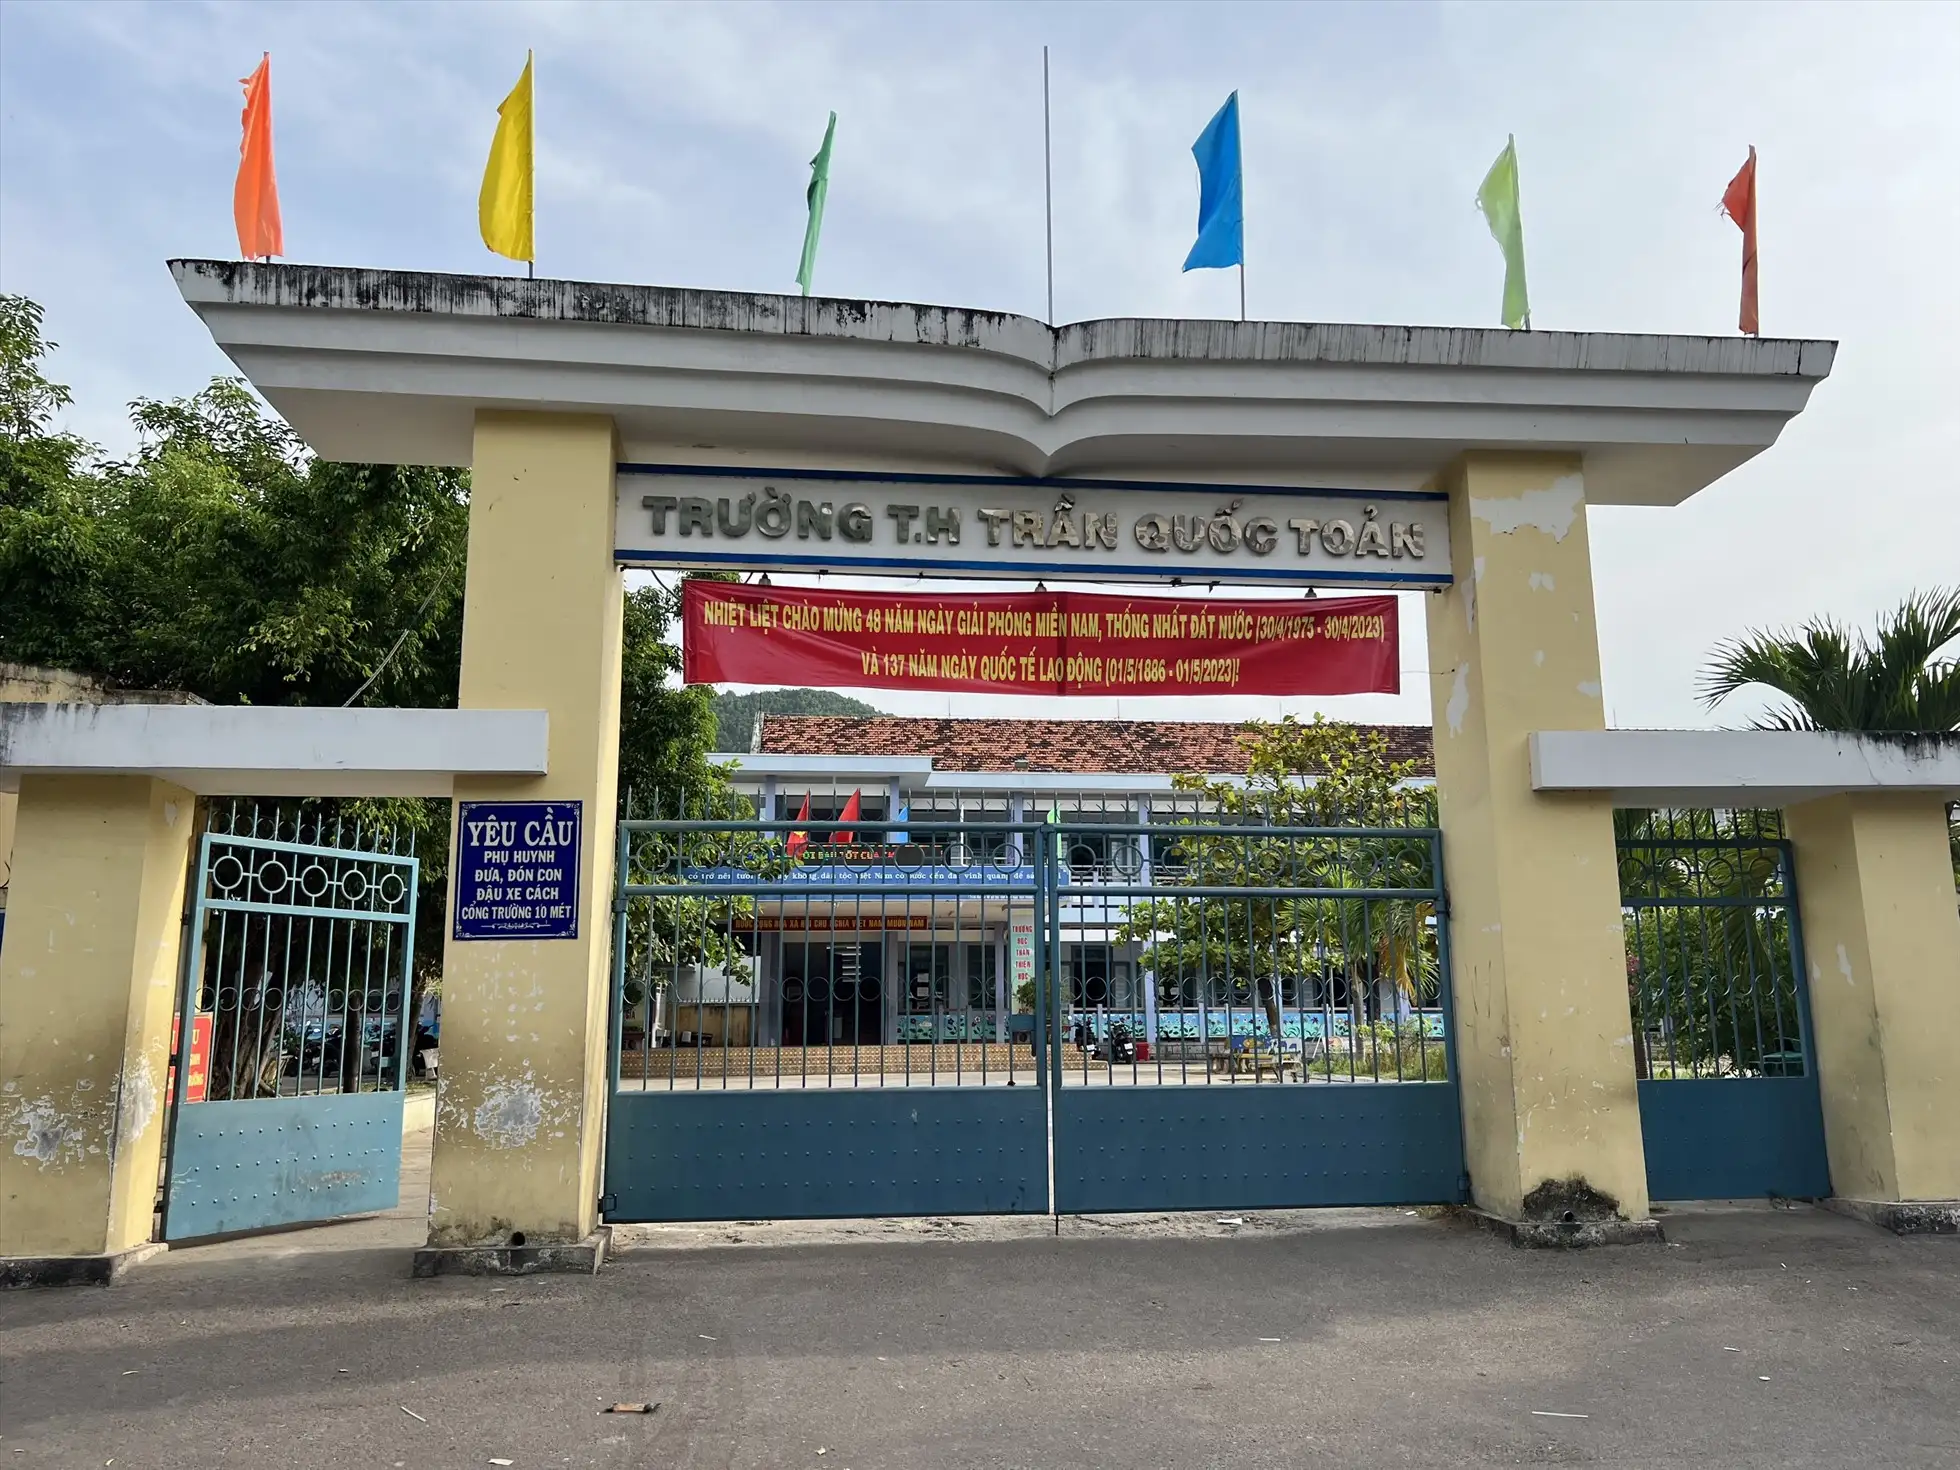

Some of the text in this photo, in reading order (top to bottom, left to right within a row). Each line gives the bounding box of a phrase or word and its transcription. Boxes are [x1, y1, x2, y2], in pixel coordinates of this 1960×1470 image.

[642, 486, 1426, 559] TRƯỜNG T.H TRẦN QUỐC TOẢN
[704, 597, 746, 633] NHIỆT
[750, 599, 779, 635] LIỆT
[782, 599, 820, 631] CHÀO
[823, 599, 862, 633] MỪNG
[866, 608, 881, 633] 48
[885, 602, 914, 634] NĂM
[917, 603, 954, 634] NGÀY
[957, 601, 984, 635] GIẢI
[987, 605, 1032, 637] PHÓNG
[1036, 602, 1067, 637] MIỀN
[1071, 613, 1102, 642] NAM,
[1106, 602, 1149, 639] THỐNG
[1152, 604, 1187, 639] NHẤT
[1190, 604, 1216, 639] ĐẤT
[1219, 608, 1254, 640] NƯỚC
[1255, 615, 1315, 644] (30/4/1975
[1324, 615, 1385, 643] 30/4/2023)
[861, 646, 879, 675] VÀ
[883, 653, 904, 676] 137
[908, 648, 938, 678] NĂM
[941, 648, 978, 680] NGÀY
[980, 646, 1016, 681] QUỐC
[1019, 646, 1036, 681] TẾ
[1040, 657, 1064, 682] LAO
[1066, 651, 1102, 689] ĐỘNG
[1105, 657, 1166, 687] (01/5/1886
[467, 807, 573, 847] YÊU CẦU
[483, 850, 555, 866] PHỤ HUYNH
[474, 866, 562, 884] ĐƯA, ĐÓN CON
[476, 884, 559, 903] ĐẬU XE CÁCH
[461, 900, 572, 920] CỔNG TRƯỜNG 10 MÉT
